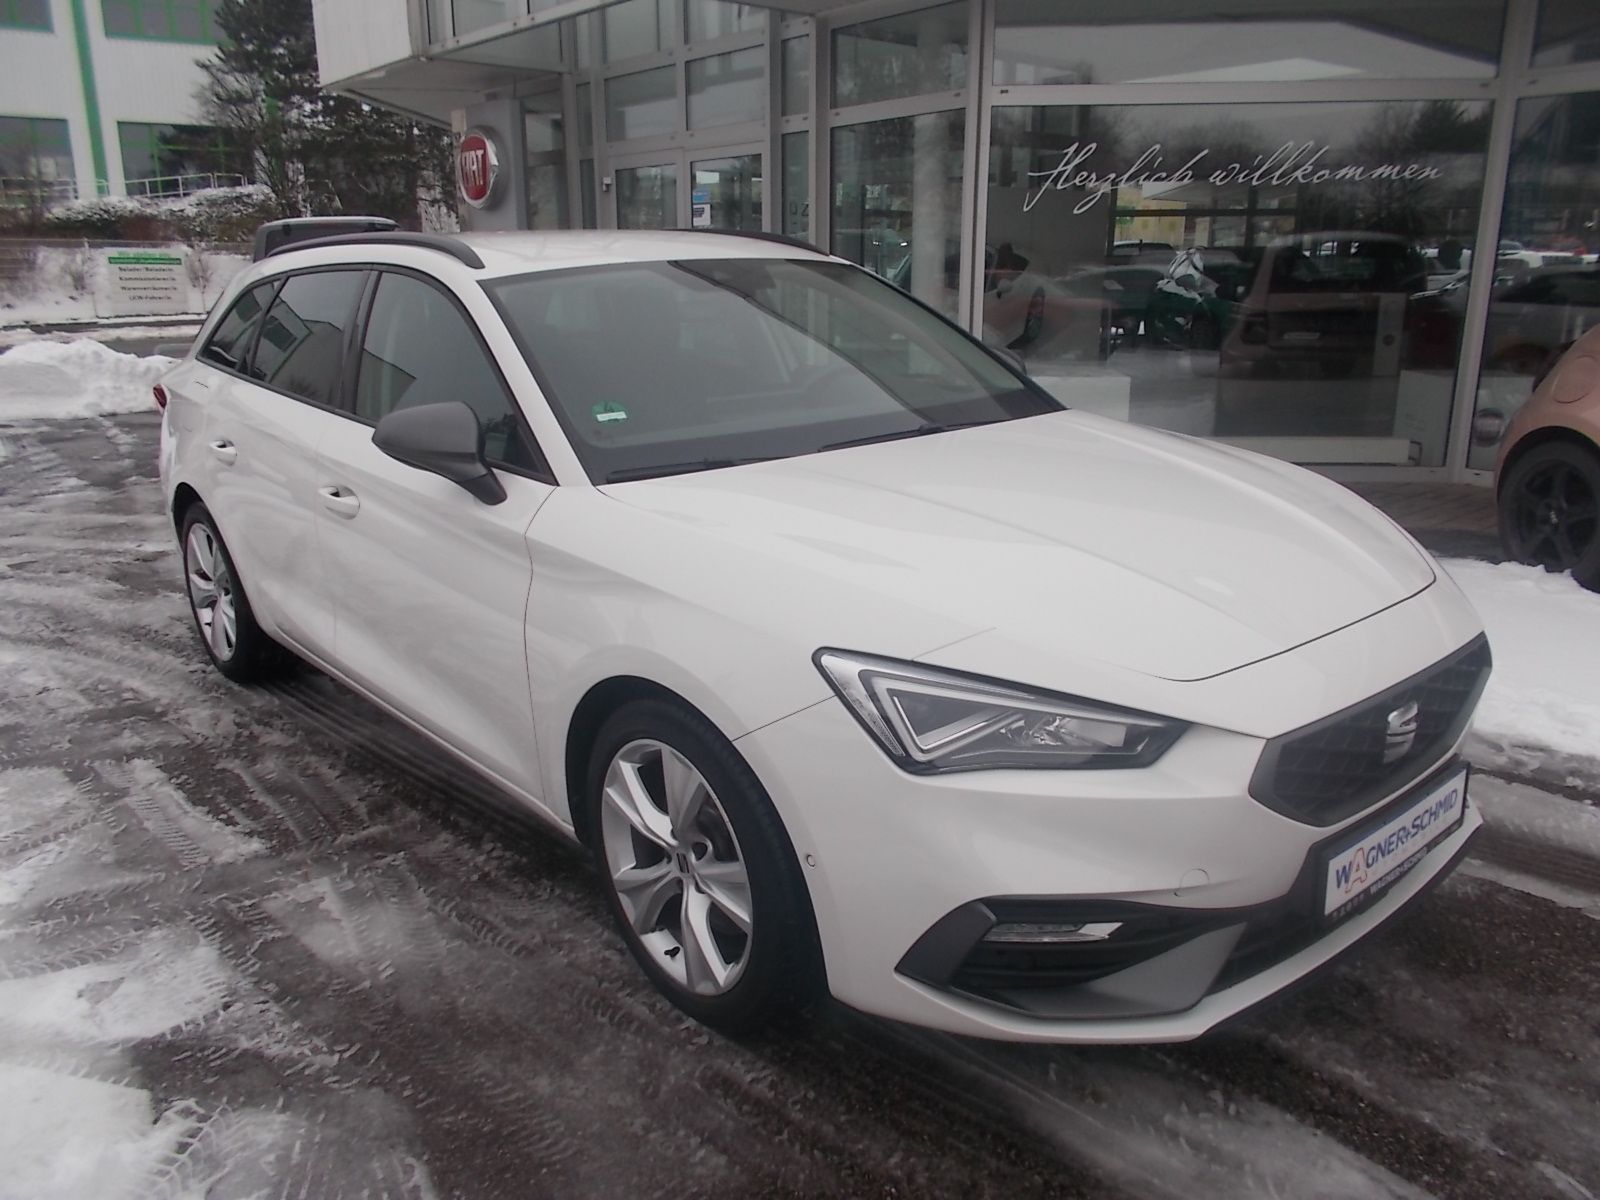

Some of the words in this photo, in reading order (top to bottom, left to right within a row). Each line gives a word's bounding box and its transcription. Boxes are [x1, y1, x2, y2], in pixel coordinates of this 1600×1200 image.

[461, 149, 485, 187] FIAT
[1023, 142, 1209, 214] Herzlich
[1209, 140, 1443, 187] willkommen
[1335, 788, 1458, 893] WAGNER+SCHMID
